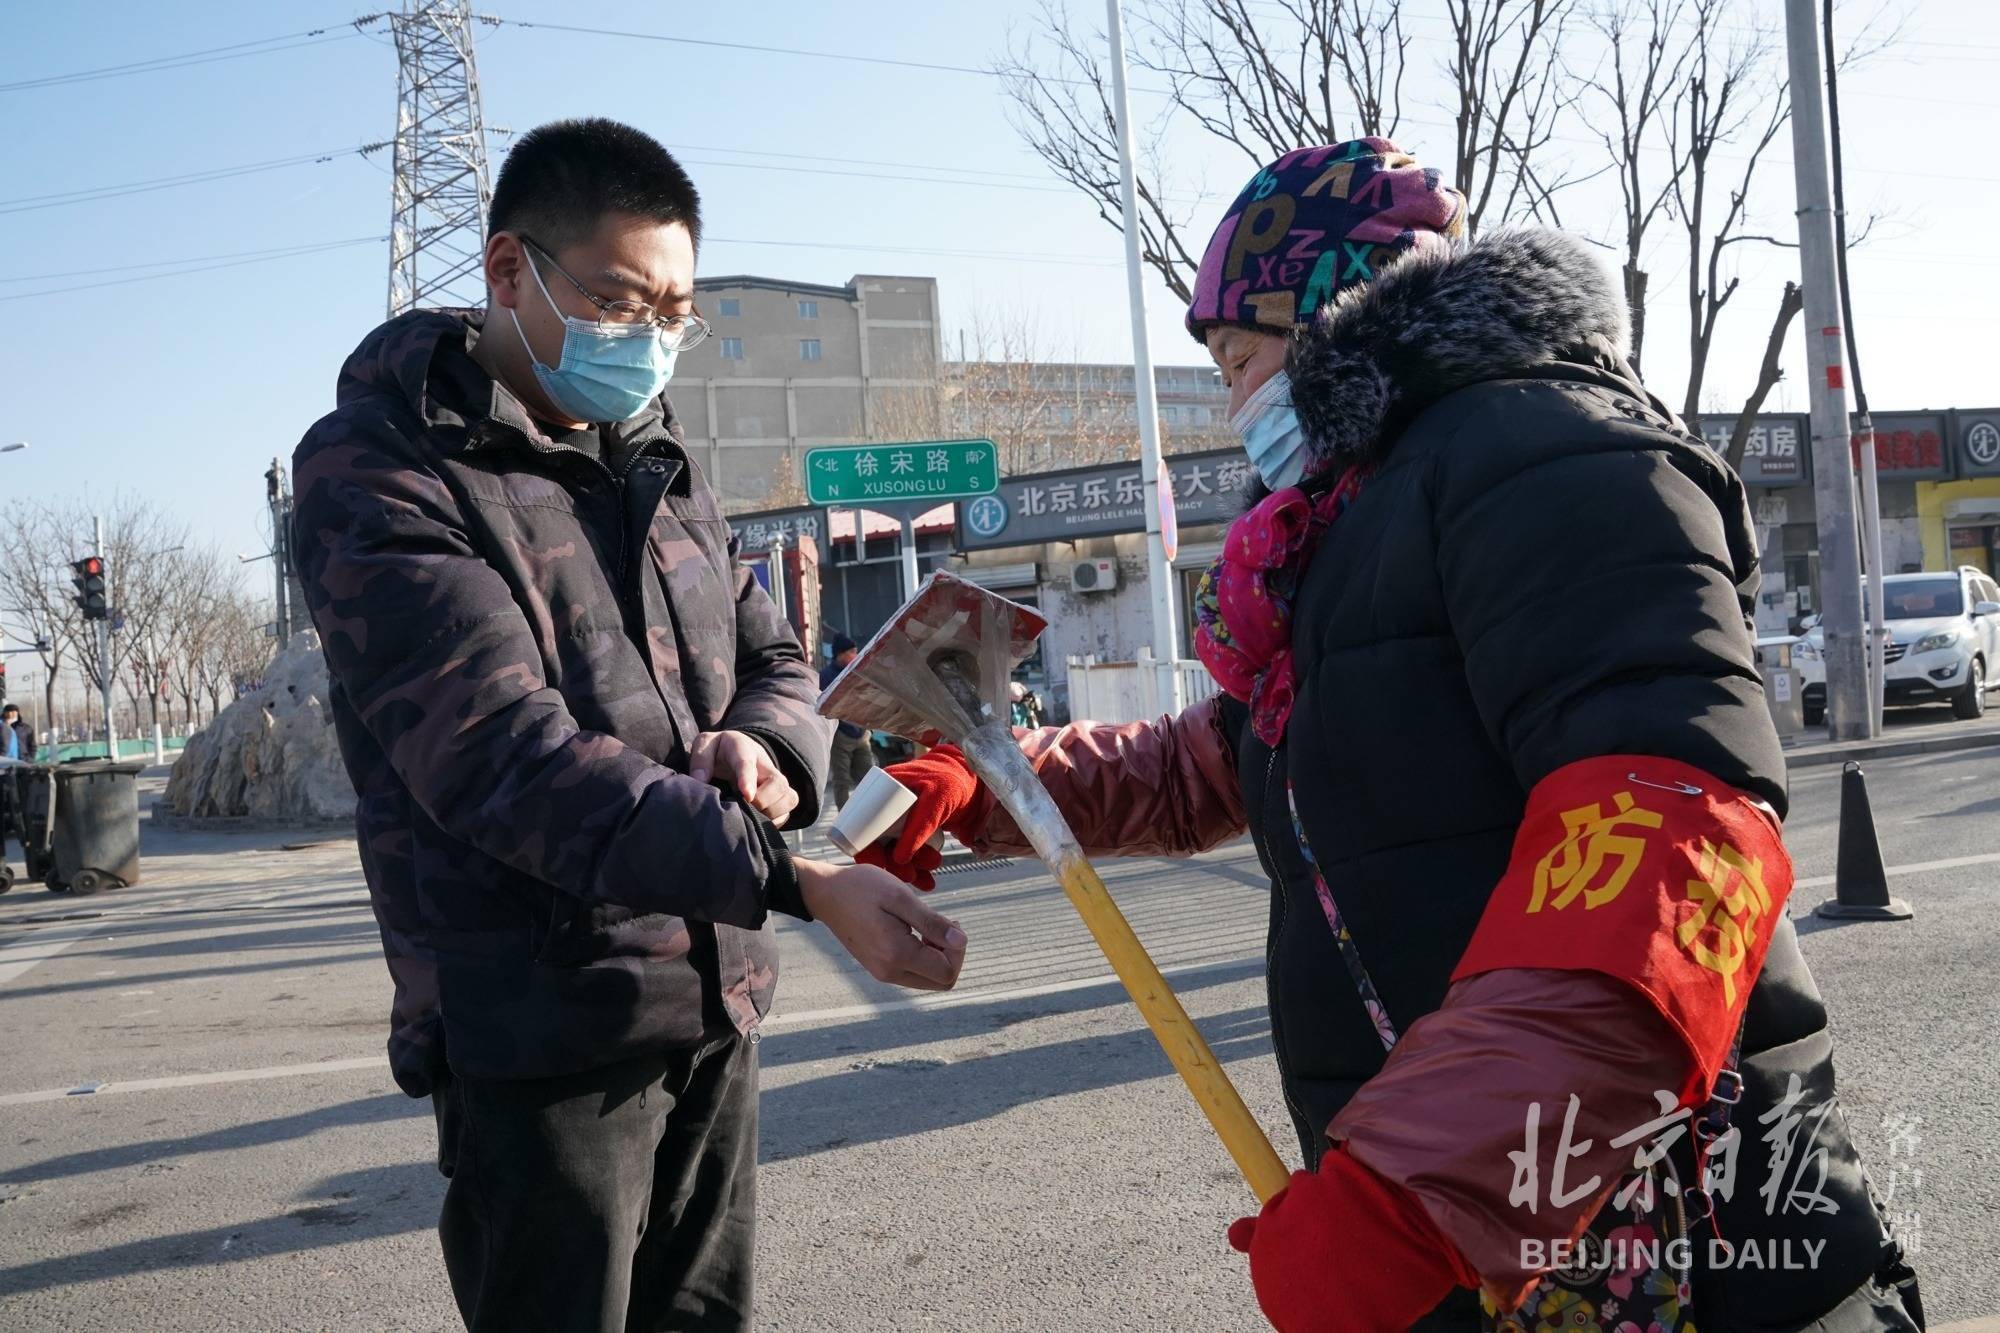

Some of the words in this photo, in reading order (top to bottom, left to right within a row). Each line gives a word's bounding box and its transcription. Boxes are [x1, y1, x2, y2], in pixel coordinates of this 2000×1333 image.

[1701, 426, 1797, 457] 大药房
[825, 458, 839, 472] 北
[854, 449, 950, 477] 徐宋路
[965, 451, 979, 465] 南
[828, 484, 839, 497] N
[969, 476, 979, 489] S
[1017, 461, 1247, 517] 北京乐乐大药
[1066, 513, 1100, 524] BEIJING
[1102, 509, 1124, 520] LELE
[1126, 507, 1145, 516] HAL
[731, 516, 819, 548] 缘米粉
[1525, 791, 1772, 1012] 防疫
